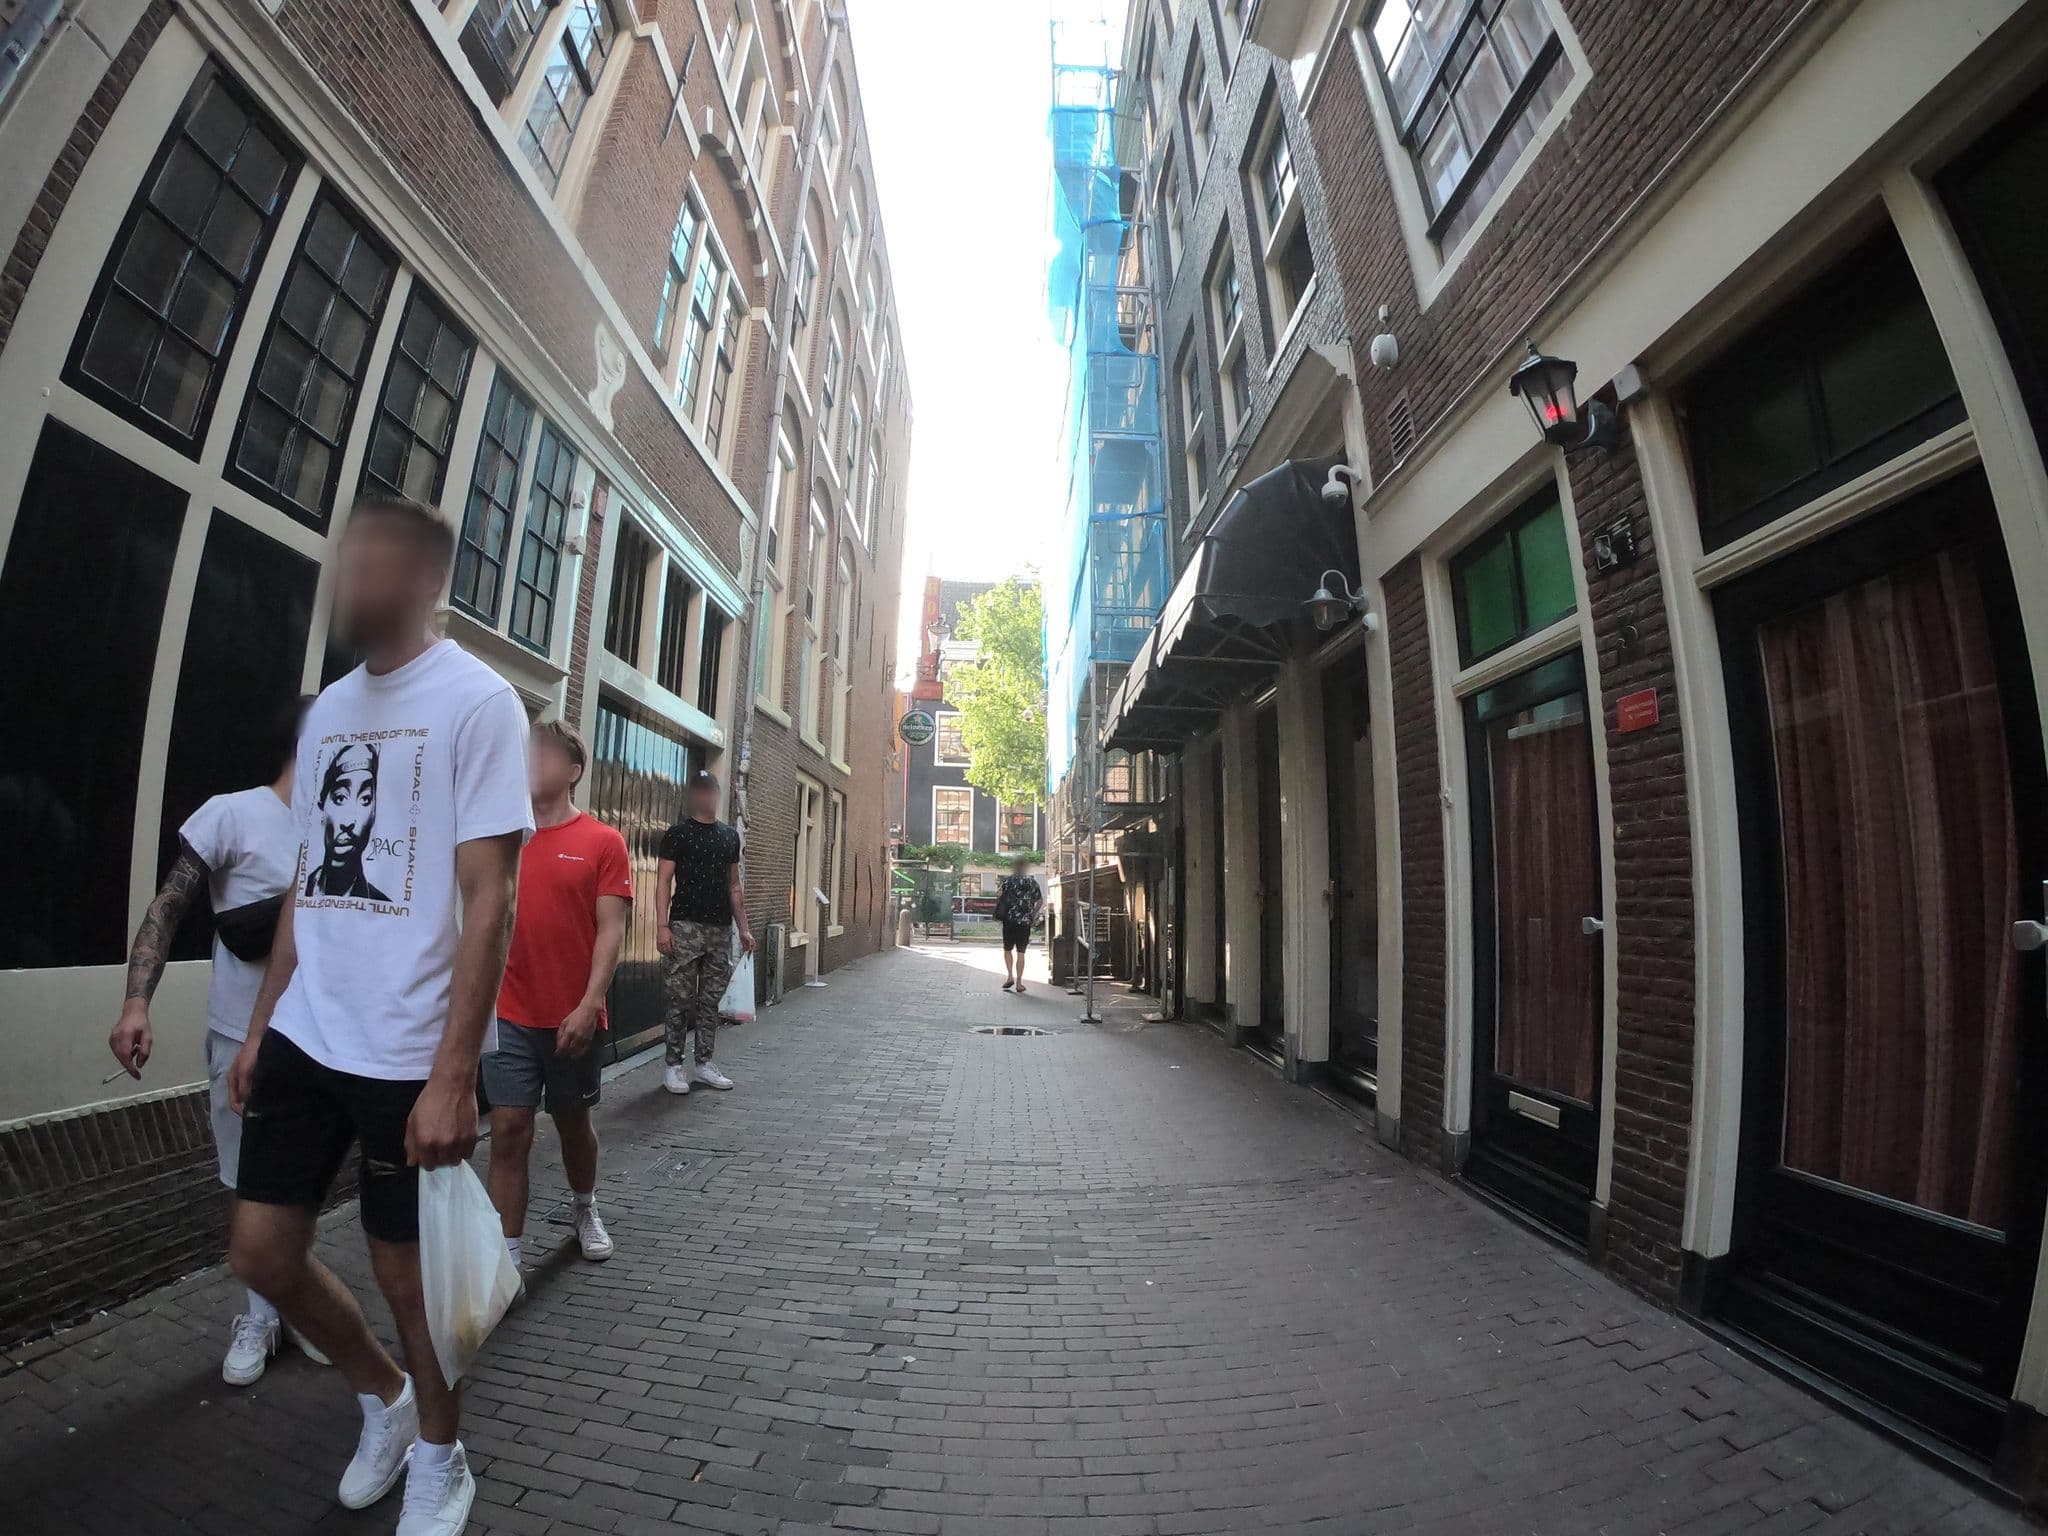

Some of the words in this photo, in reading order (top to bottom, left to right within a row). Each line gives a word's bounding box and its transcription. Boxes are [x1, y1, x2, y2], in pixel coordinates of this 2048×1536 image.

[321, 734, 348, 744] UNTIL
[349, 731, 369, 742] THE
[369, 730, 388, 741] END
[389, 729, 403, 738] OF
[404, 728, 429, 737] TIME
[412, 742, 425, 802] TUPAC
[299, 839, 309, 891] TUPAC
[403, 826, 417, 902] SHAKUR
[368, 903, 410, 917] UNTIL
